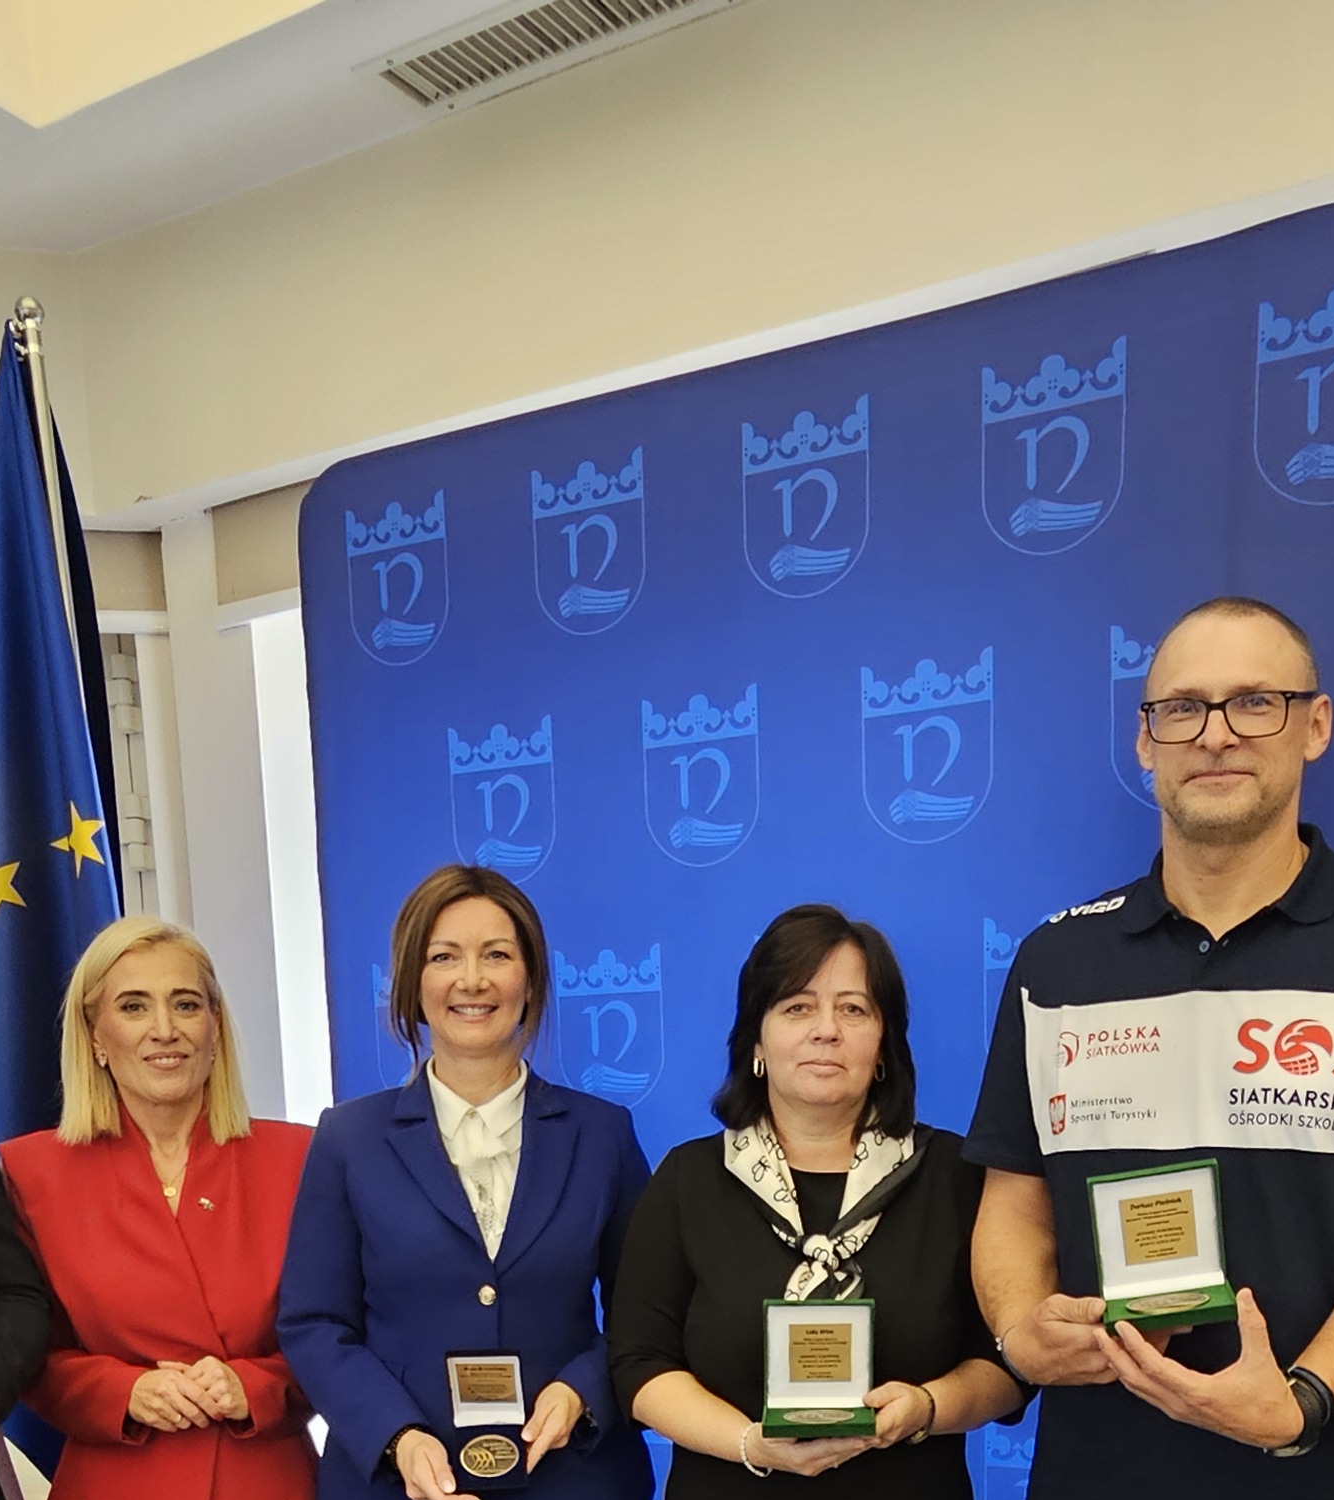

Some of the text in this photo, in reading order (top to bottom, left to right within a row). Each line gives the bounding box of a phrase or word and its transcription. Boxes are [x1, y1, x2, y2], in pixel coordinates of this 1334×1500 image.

[1088, 1026, 1161, 1045] POLSKA
[1086, 1042, 1160, 1060] SIATKÓWKA
[1070, 1097, 1133, 1108] Ministerstwo
[1070, 1112, 1101, 1124] Sportu
[1110, 1109, 1157, 1122] Turystyki
[1228, 1110, 1294, 1126] OŚRODKI
